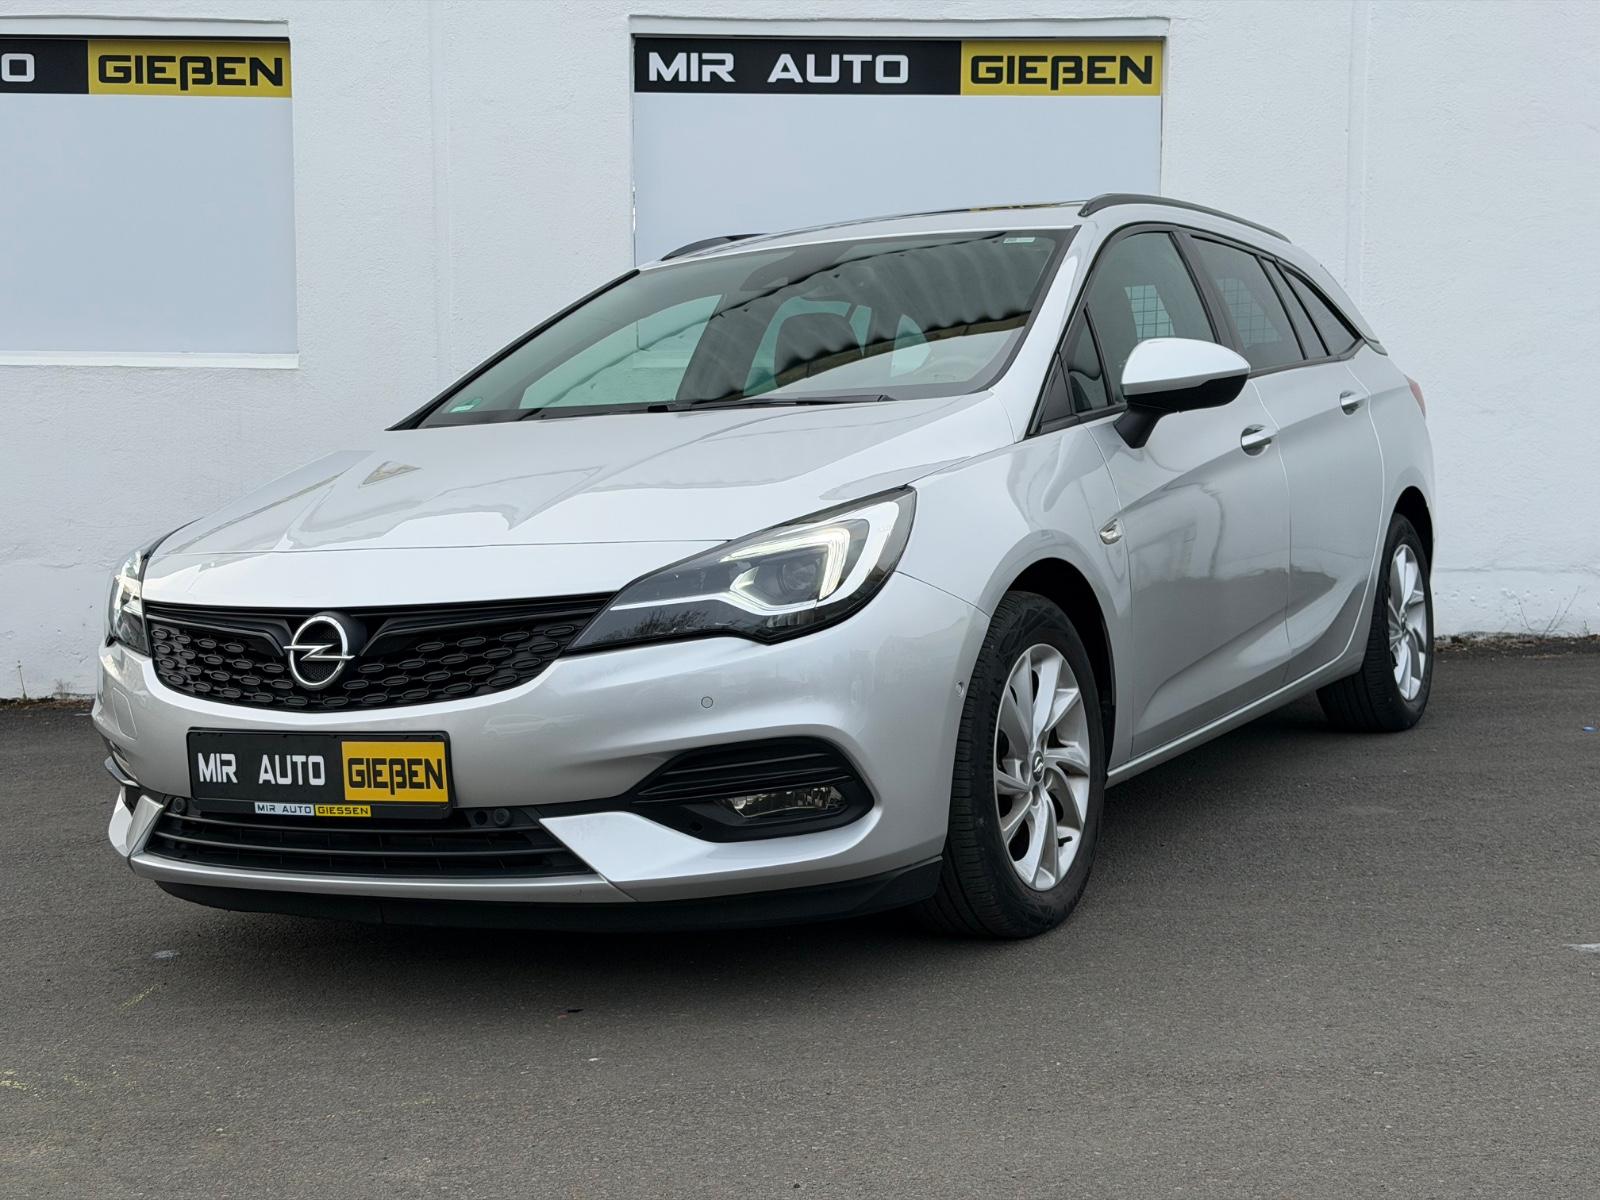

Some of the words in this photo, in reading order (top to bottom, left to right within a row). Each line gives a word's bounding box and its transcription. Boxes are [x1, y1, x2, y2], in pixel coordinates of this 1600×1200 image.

[648, 52, 736, 83] MIR
[767, 53, 909, 84] AUTO
[197, 752, 238, 784] MIR
[258, 754, 326, 786] AUTO
[257, 803, 276, 813] MIR
[282, 804, 313, 815] AUTO
[317, 805, 370, 816] GIESSEN
